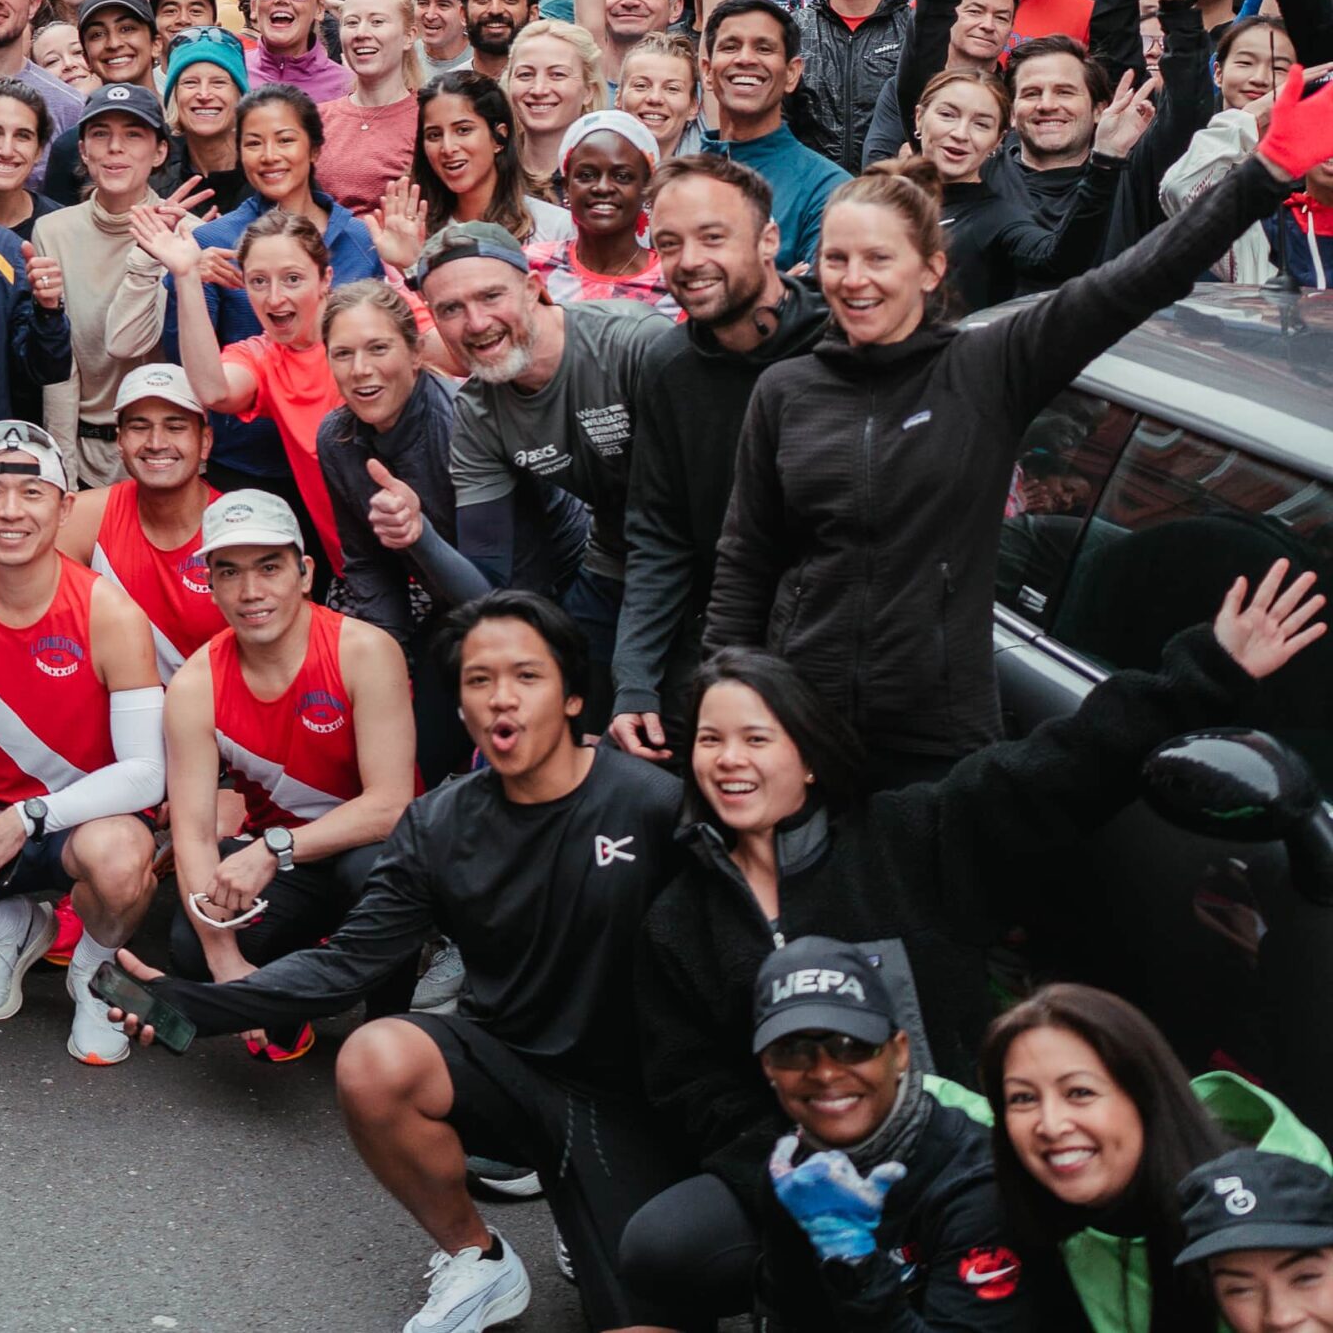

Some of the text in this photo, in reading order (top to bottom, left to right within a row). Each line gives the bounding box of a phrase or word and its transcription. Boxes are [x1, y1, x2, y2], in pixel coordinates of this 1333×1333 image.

[222, 503, 254, 518] LONDON
[182, 575, 212, 593] MMXX
[31, 635, 84, 661] LONDON
[35, 657, 78, 677] MMXXIII
[294, 689, 346, 719] LONDON
[301, 714, 346, 733] MMXXIII
[772, 967, 867, 1004] WEPA
